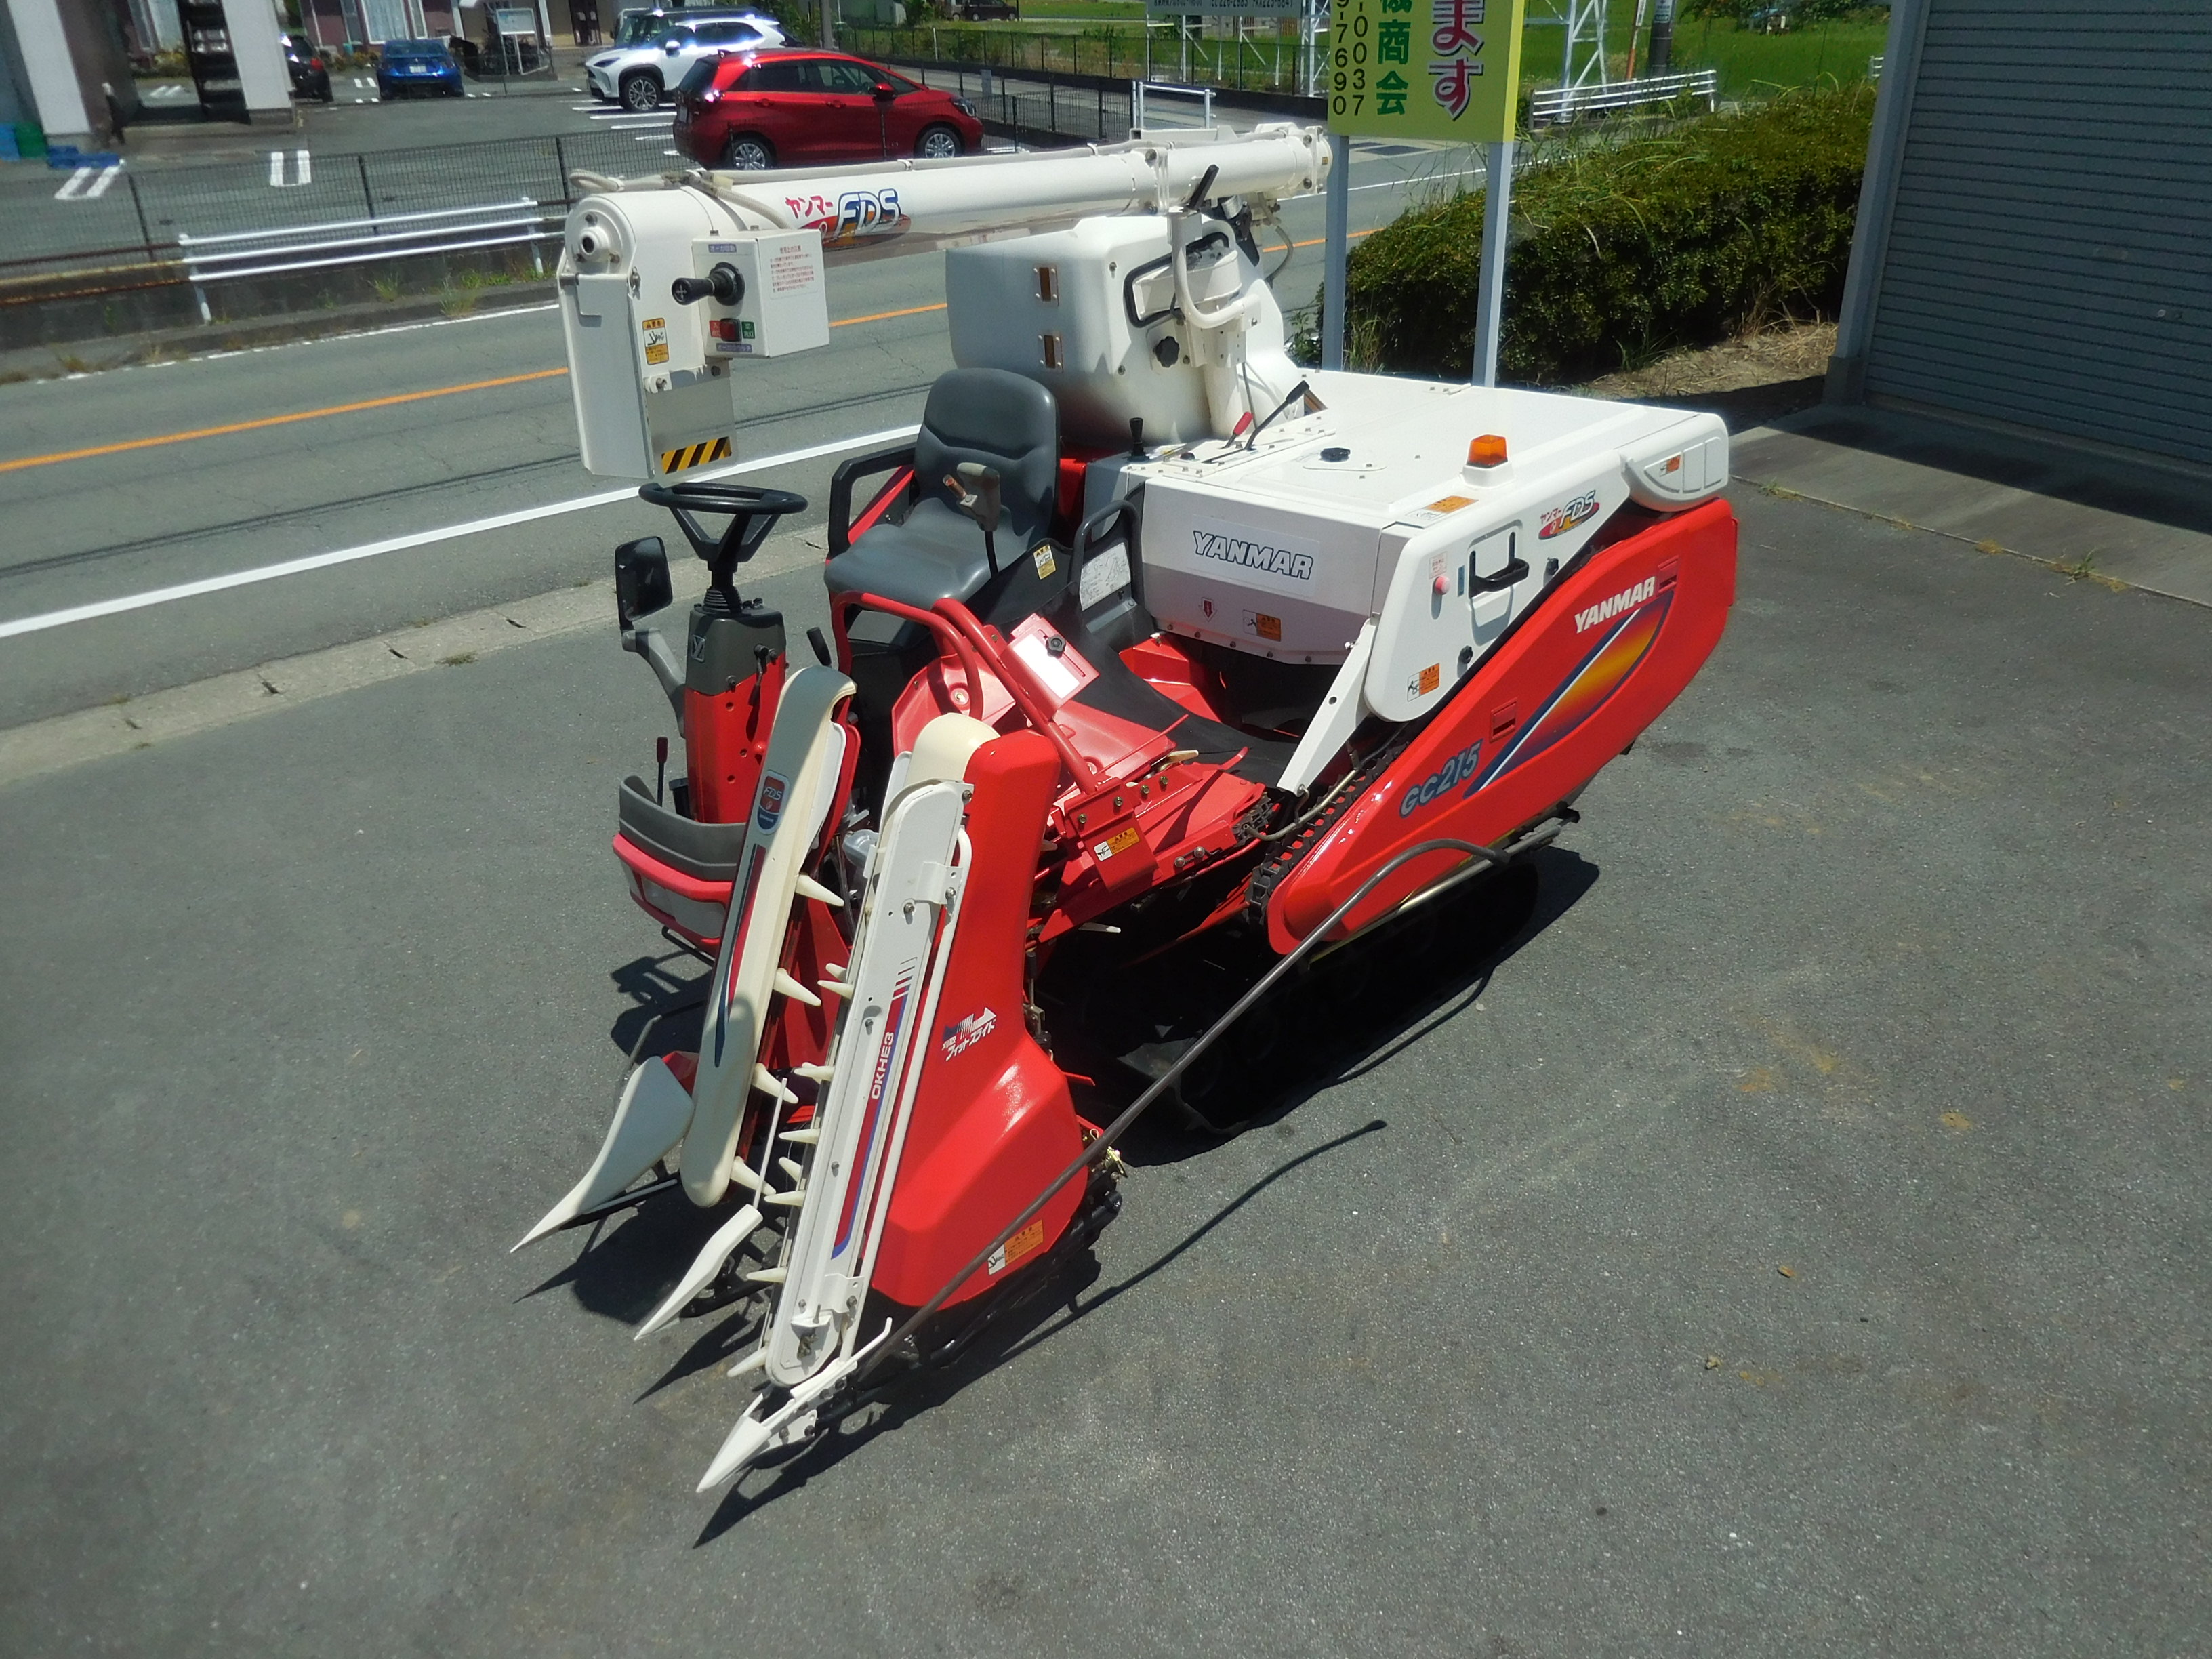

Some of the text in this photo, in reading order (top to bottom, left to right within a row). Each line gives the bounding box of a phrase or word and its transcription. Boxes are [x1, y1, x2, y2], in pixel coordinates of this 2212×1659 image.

[785, 195, 834, 219] ヤンマー
[834, 188, 903, 240] FDS
[1540, 507, 1561, 525] ヤンマー
[1559, 489, 1596, 529] FDS
[1193, 530, 1314, 581] YANMAR
[1574, 576, 1655, 634] YANMAR
[763, 786, 783, 800] FDS
[1399, 737, 1483, 818] GC215
[871, 1031, 894, 1099] OKHE3
